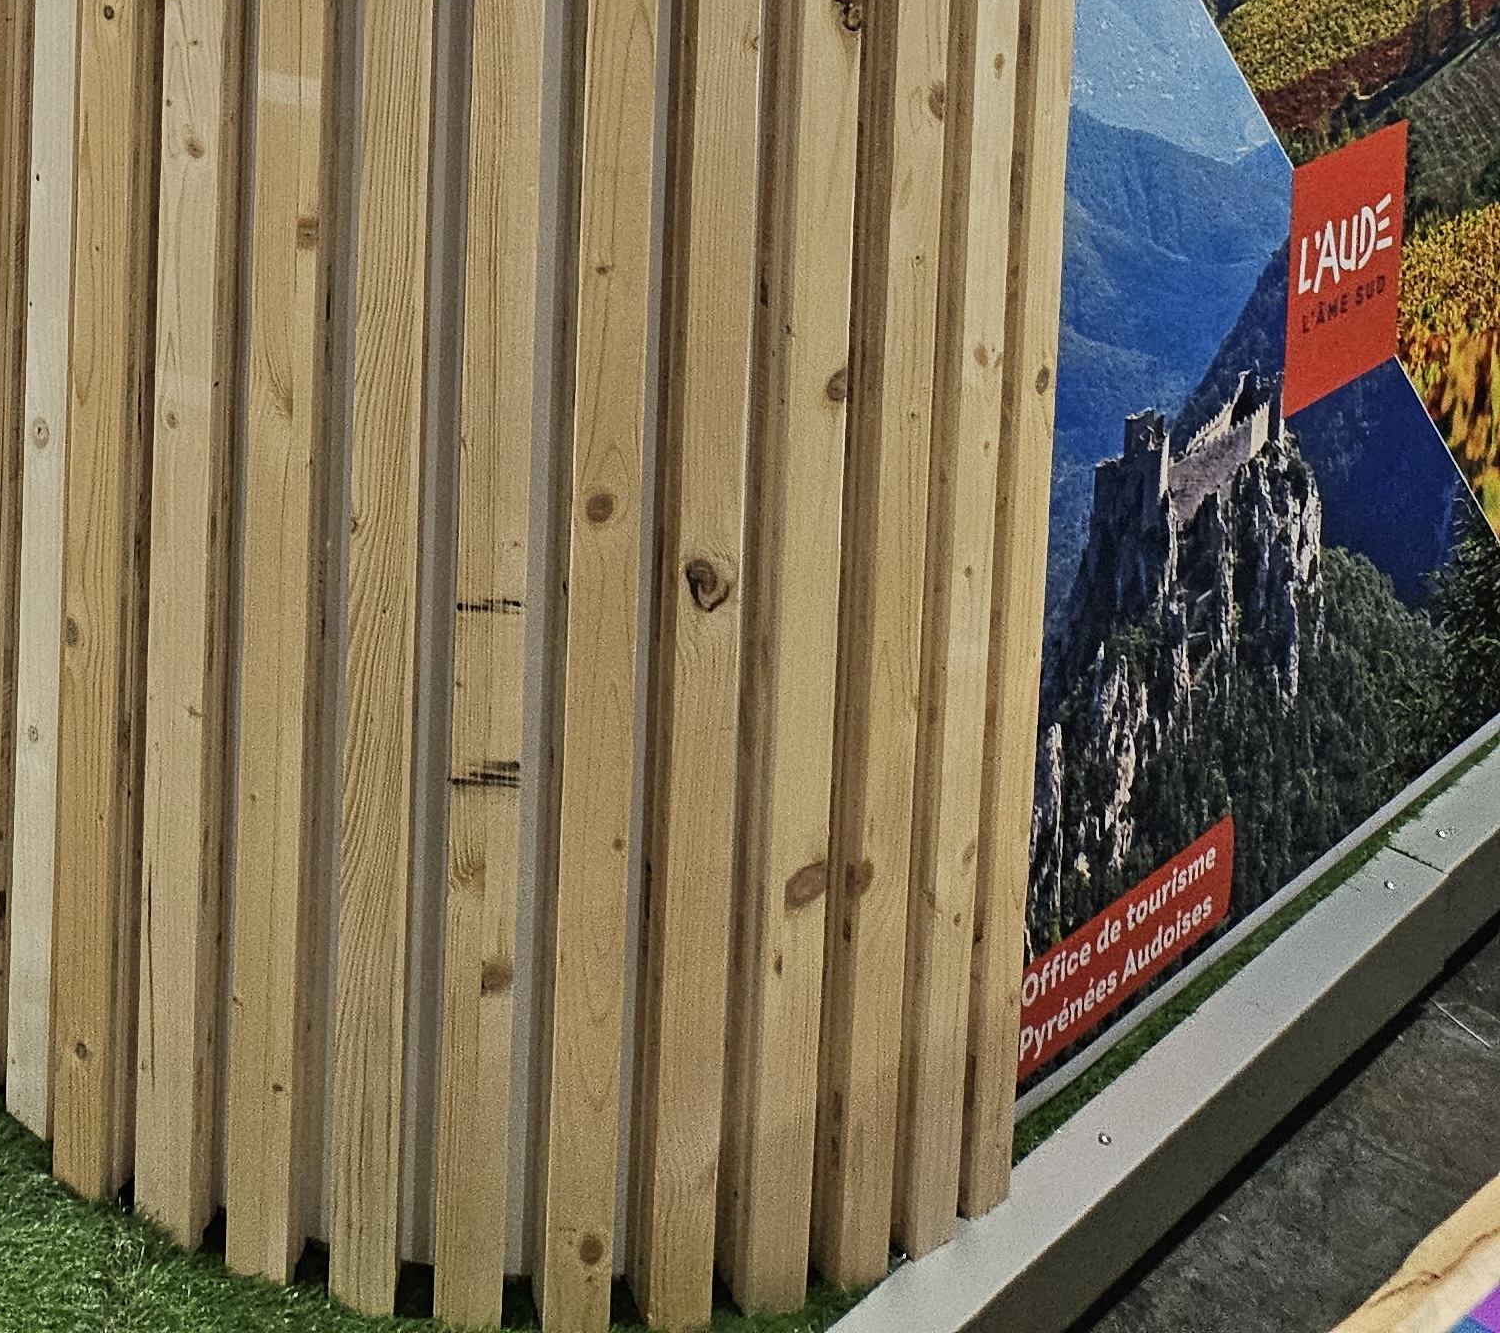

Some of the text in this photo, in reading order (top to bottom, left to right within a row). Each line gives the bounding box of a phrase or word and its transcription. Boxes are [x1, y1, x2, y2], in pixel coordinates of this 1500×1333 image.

[1298, 193, 1393, 295] L'AUDE
[1355, 274, 1385, 306] SUD
[1019, 895, 1212, 1061] Pyrénées Audoises
[1021, 846, 1217, 1008] Office de tourisme
